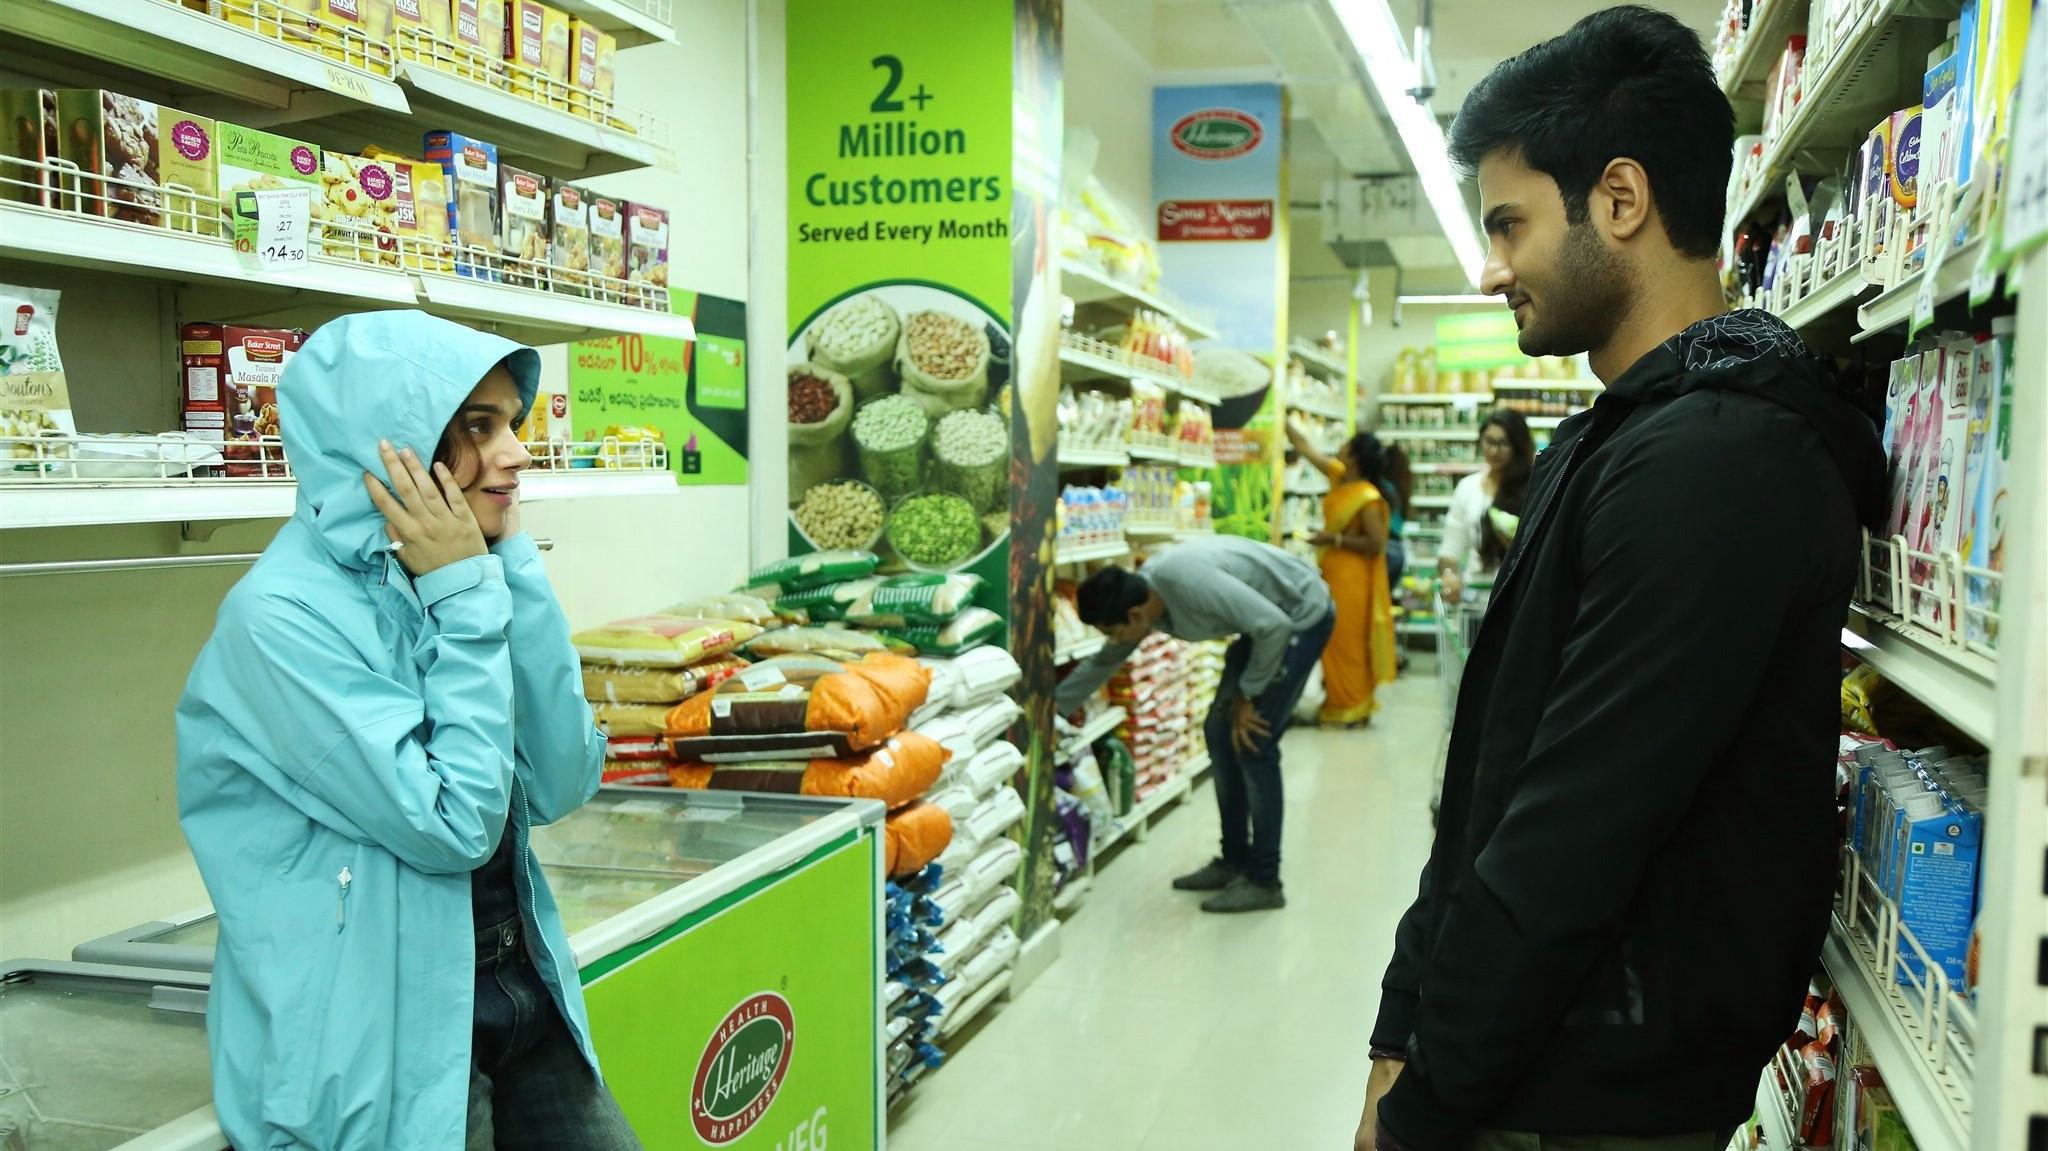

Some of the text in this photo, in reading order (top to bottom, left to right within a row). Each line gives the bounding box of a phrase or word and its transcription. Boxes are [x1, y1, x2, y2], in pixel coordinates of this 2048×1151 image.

[458, 20, 479, 39] RUSK
[838, 121, 966, 158] Million
[805, 172, 1001, 207] Customers
[1160, 202, 1206, 226] Sona
[798, 218, 1008, 244] Served Every Month
[247, 339, 282, 351] Baker Street
[238, 371, 269, 384] Masala
[719, 1000, 768, 1043] HEALTH
[699, 1043, 778, 1117] Heritage
[711, 1078, 778, 1139] HAPPINESS
